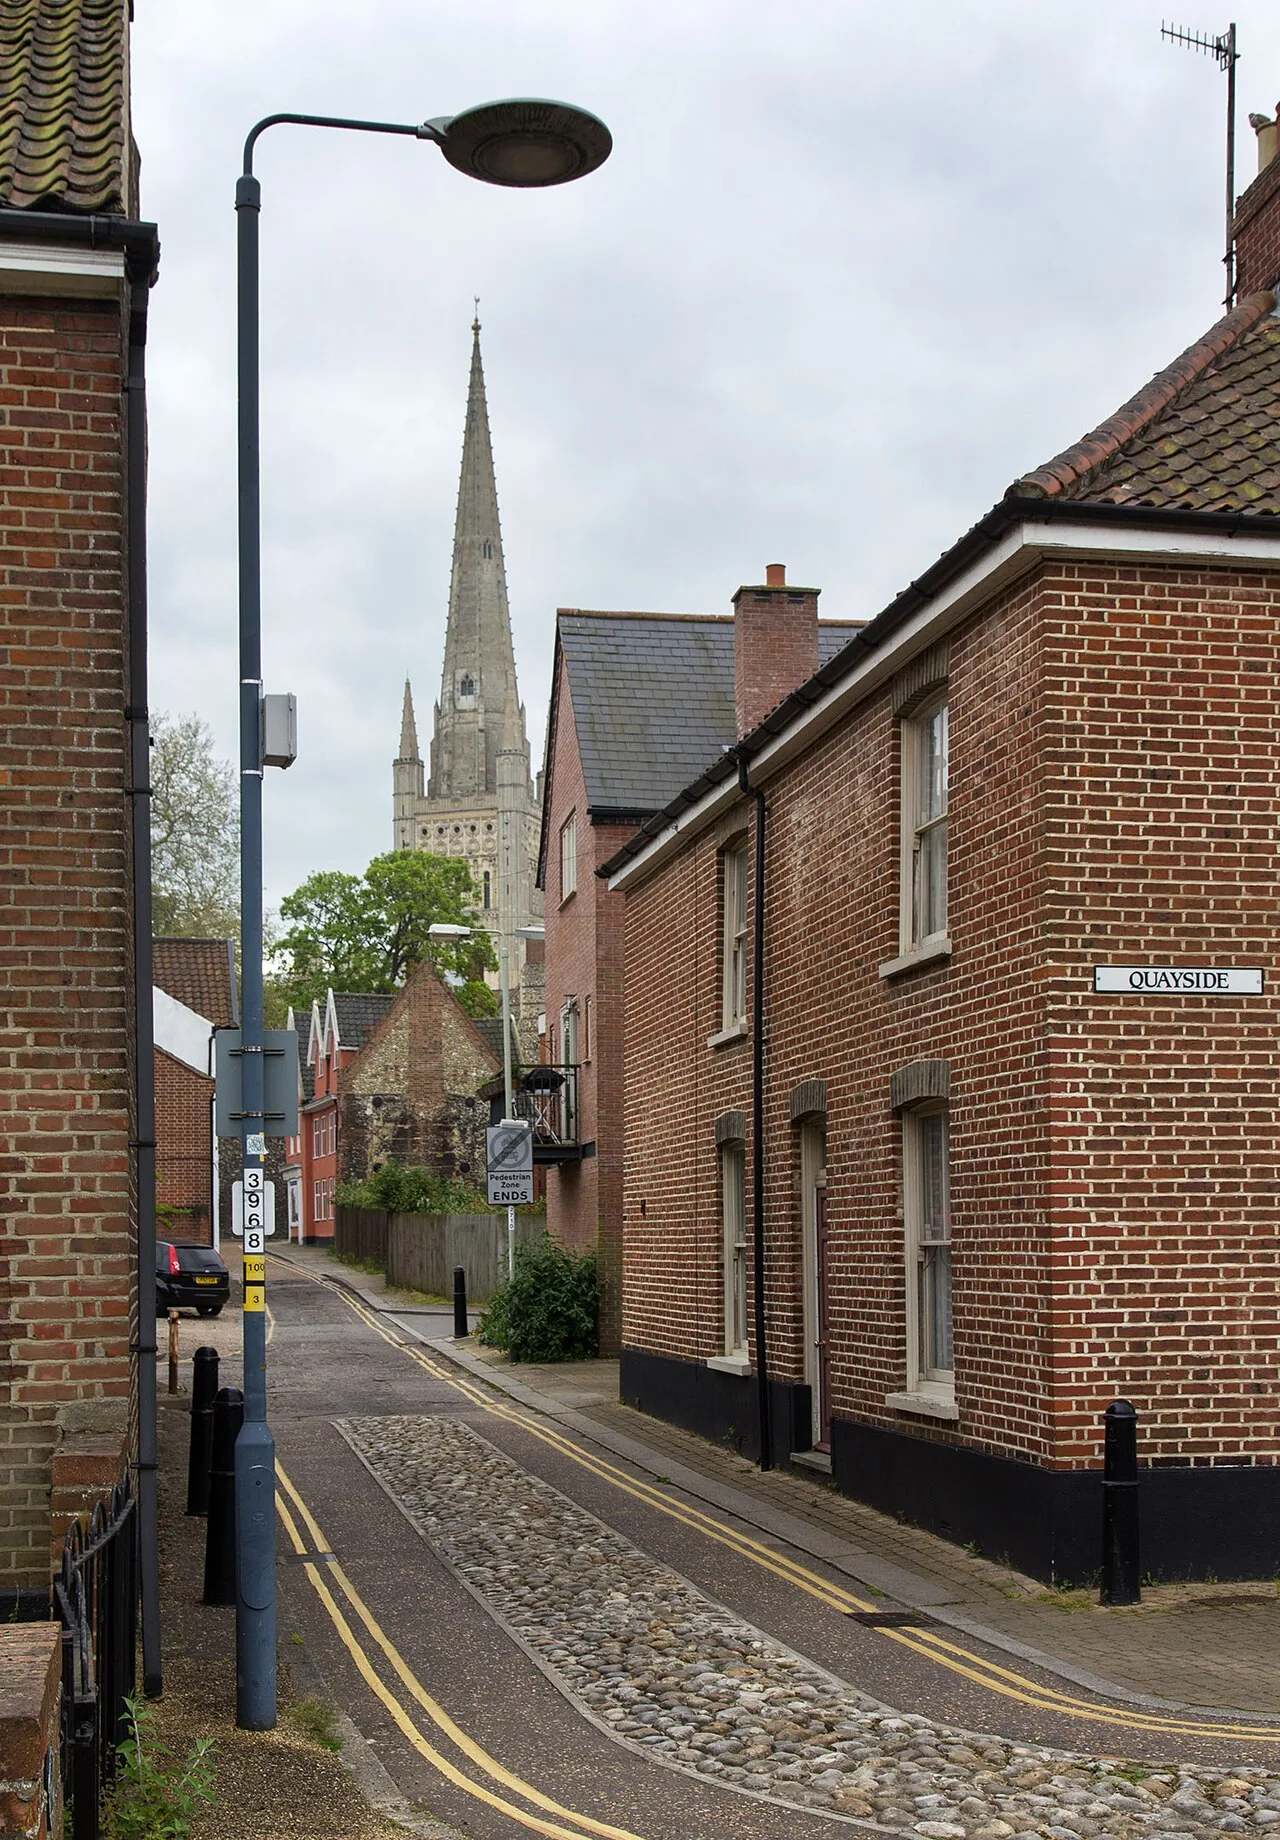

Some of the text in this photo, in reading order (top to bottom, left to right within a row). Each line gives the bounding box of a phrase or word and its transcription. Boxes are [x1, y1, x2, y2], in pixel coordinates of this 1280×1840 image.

[1129, 971, 1229, 989] QUAYSIDE
[493, 1191, 528, 1201] ENDS
[253, 1295, 260, 1304] 3
